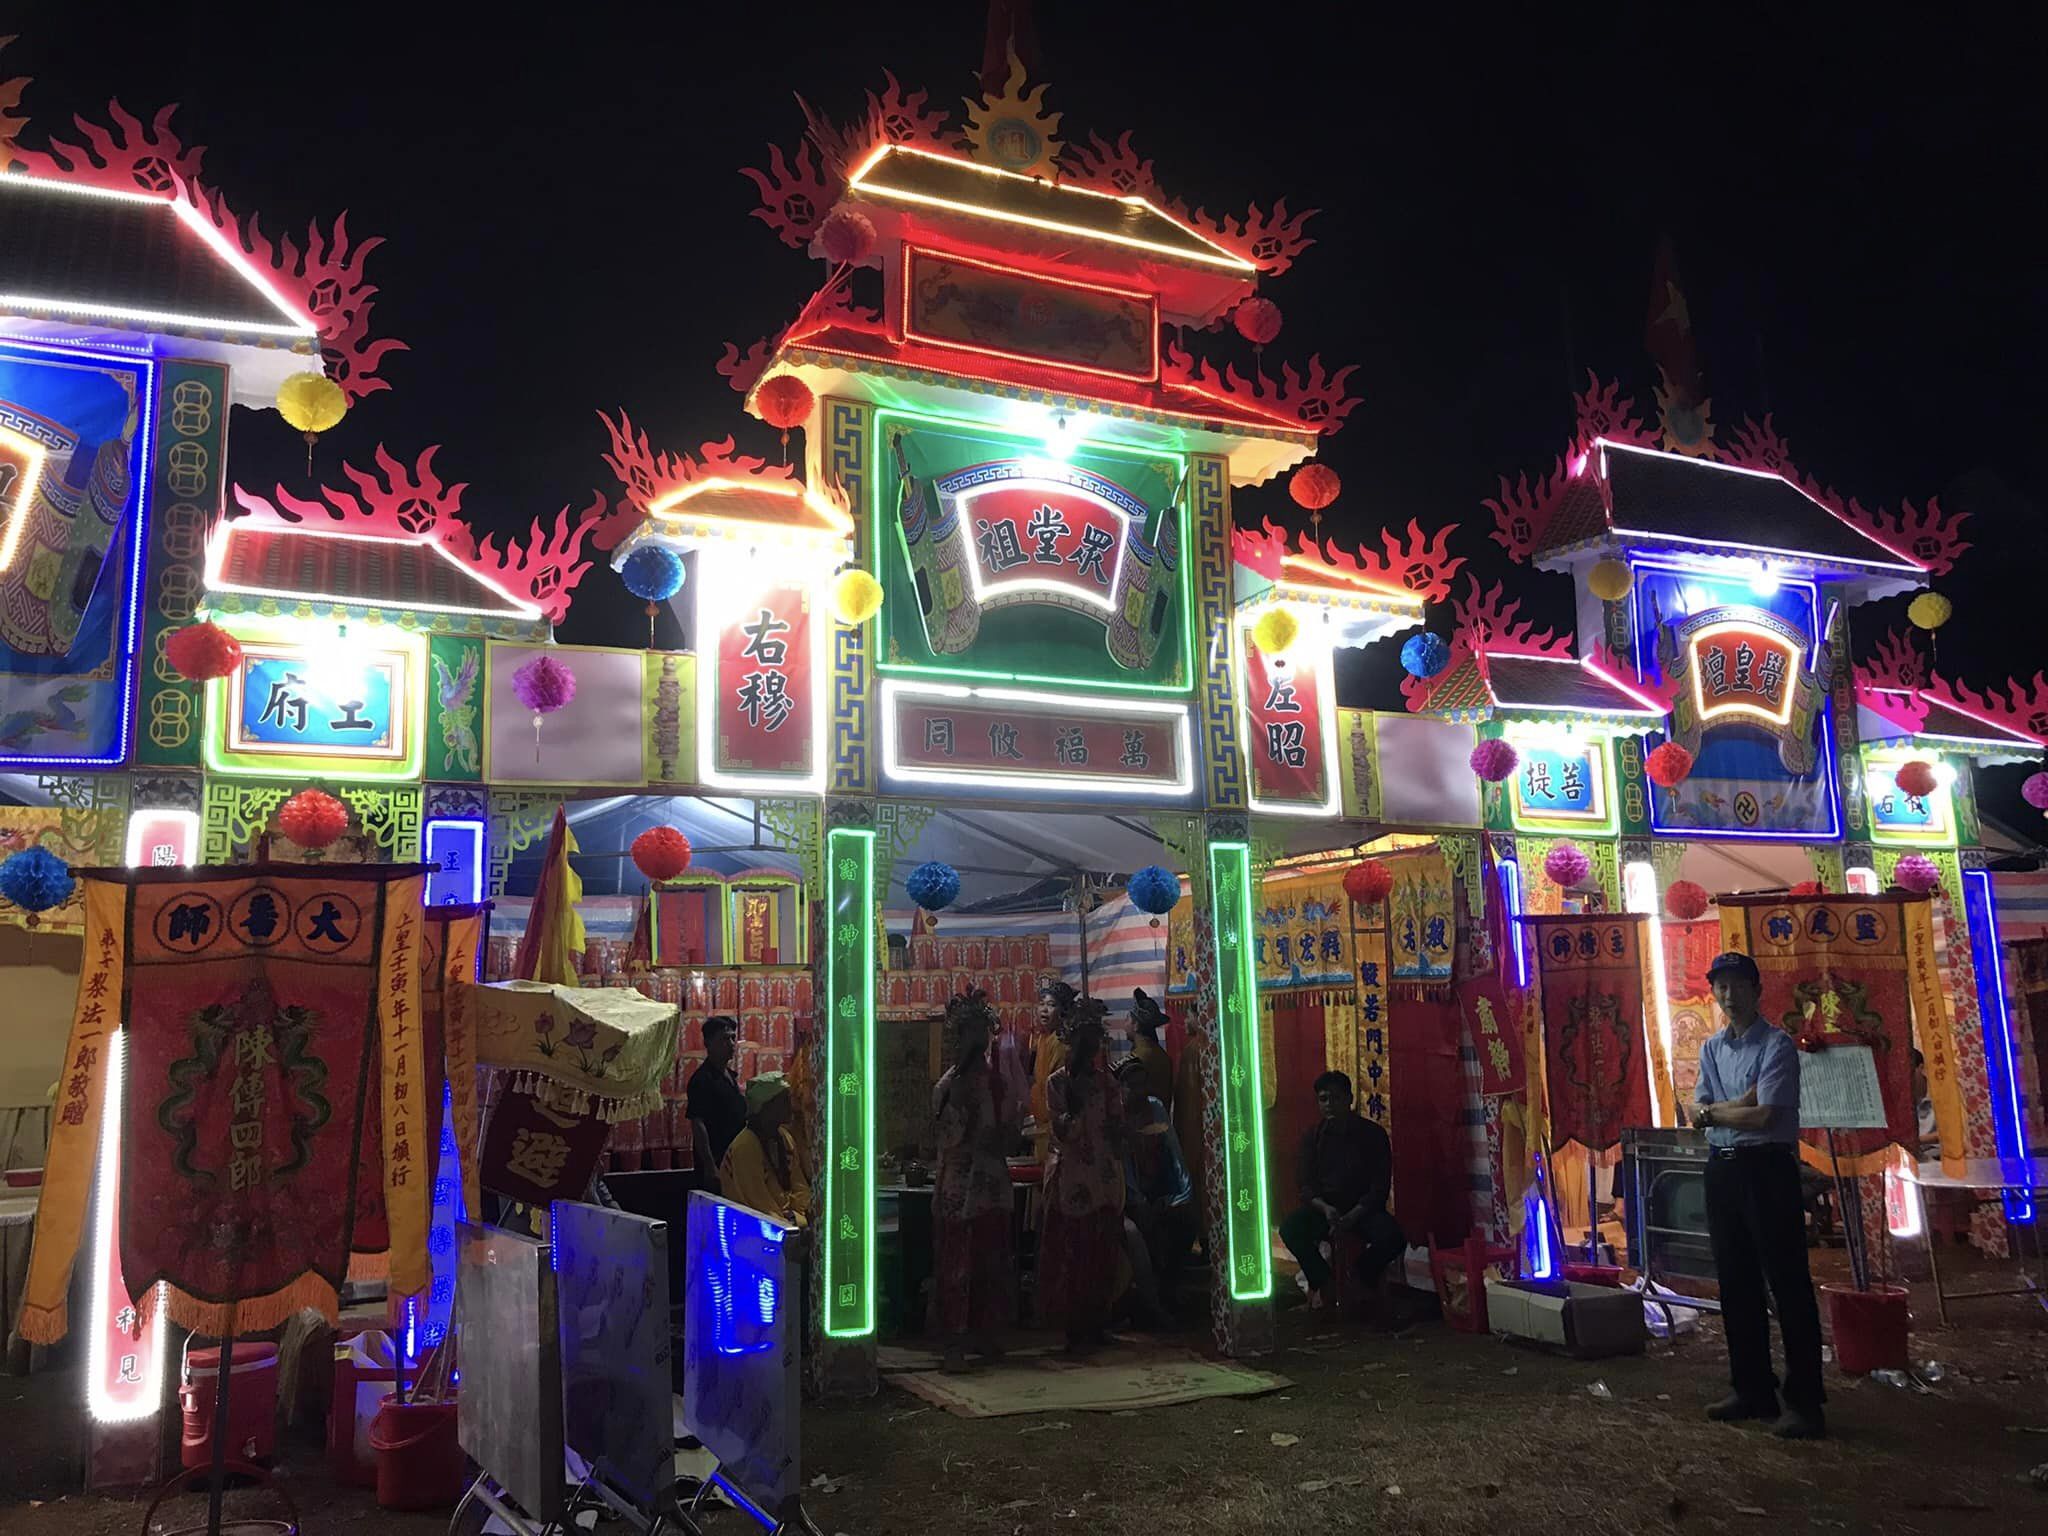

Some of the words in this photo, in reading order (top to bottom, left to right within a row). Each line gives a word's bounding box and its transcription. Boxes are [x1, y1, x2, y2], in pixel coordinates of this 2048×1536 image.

[736, 608, 794, 732] 右穆
[924, 718, 1150, 769] 萬福攸同
[1264, 678, 1307, 768] 左昭
[1526, 761, 1585, 800] 菩提
